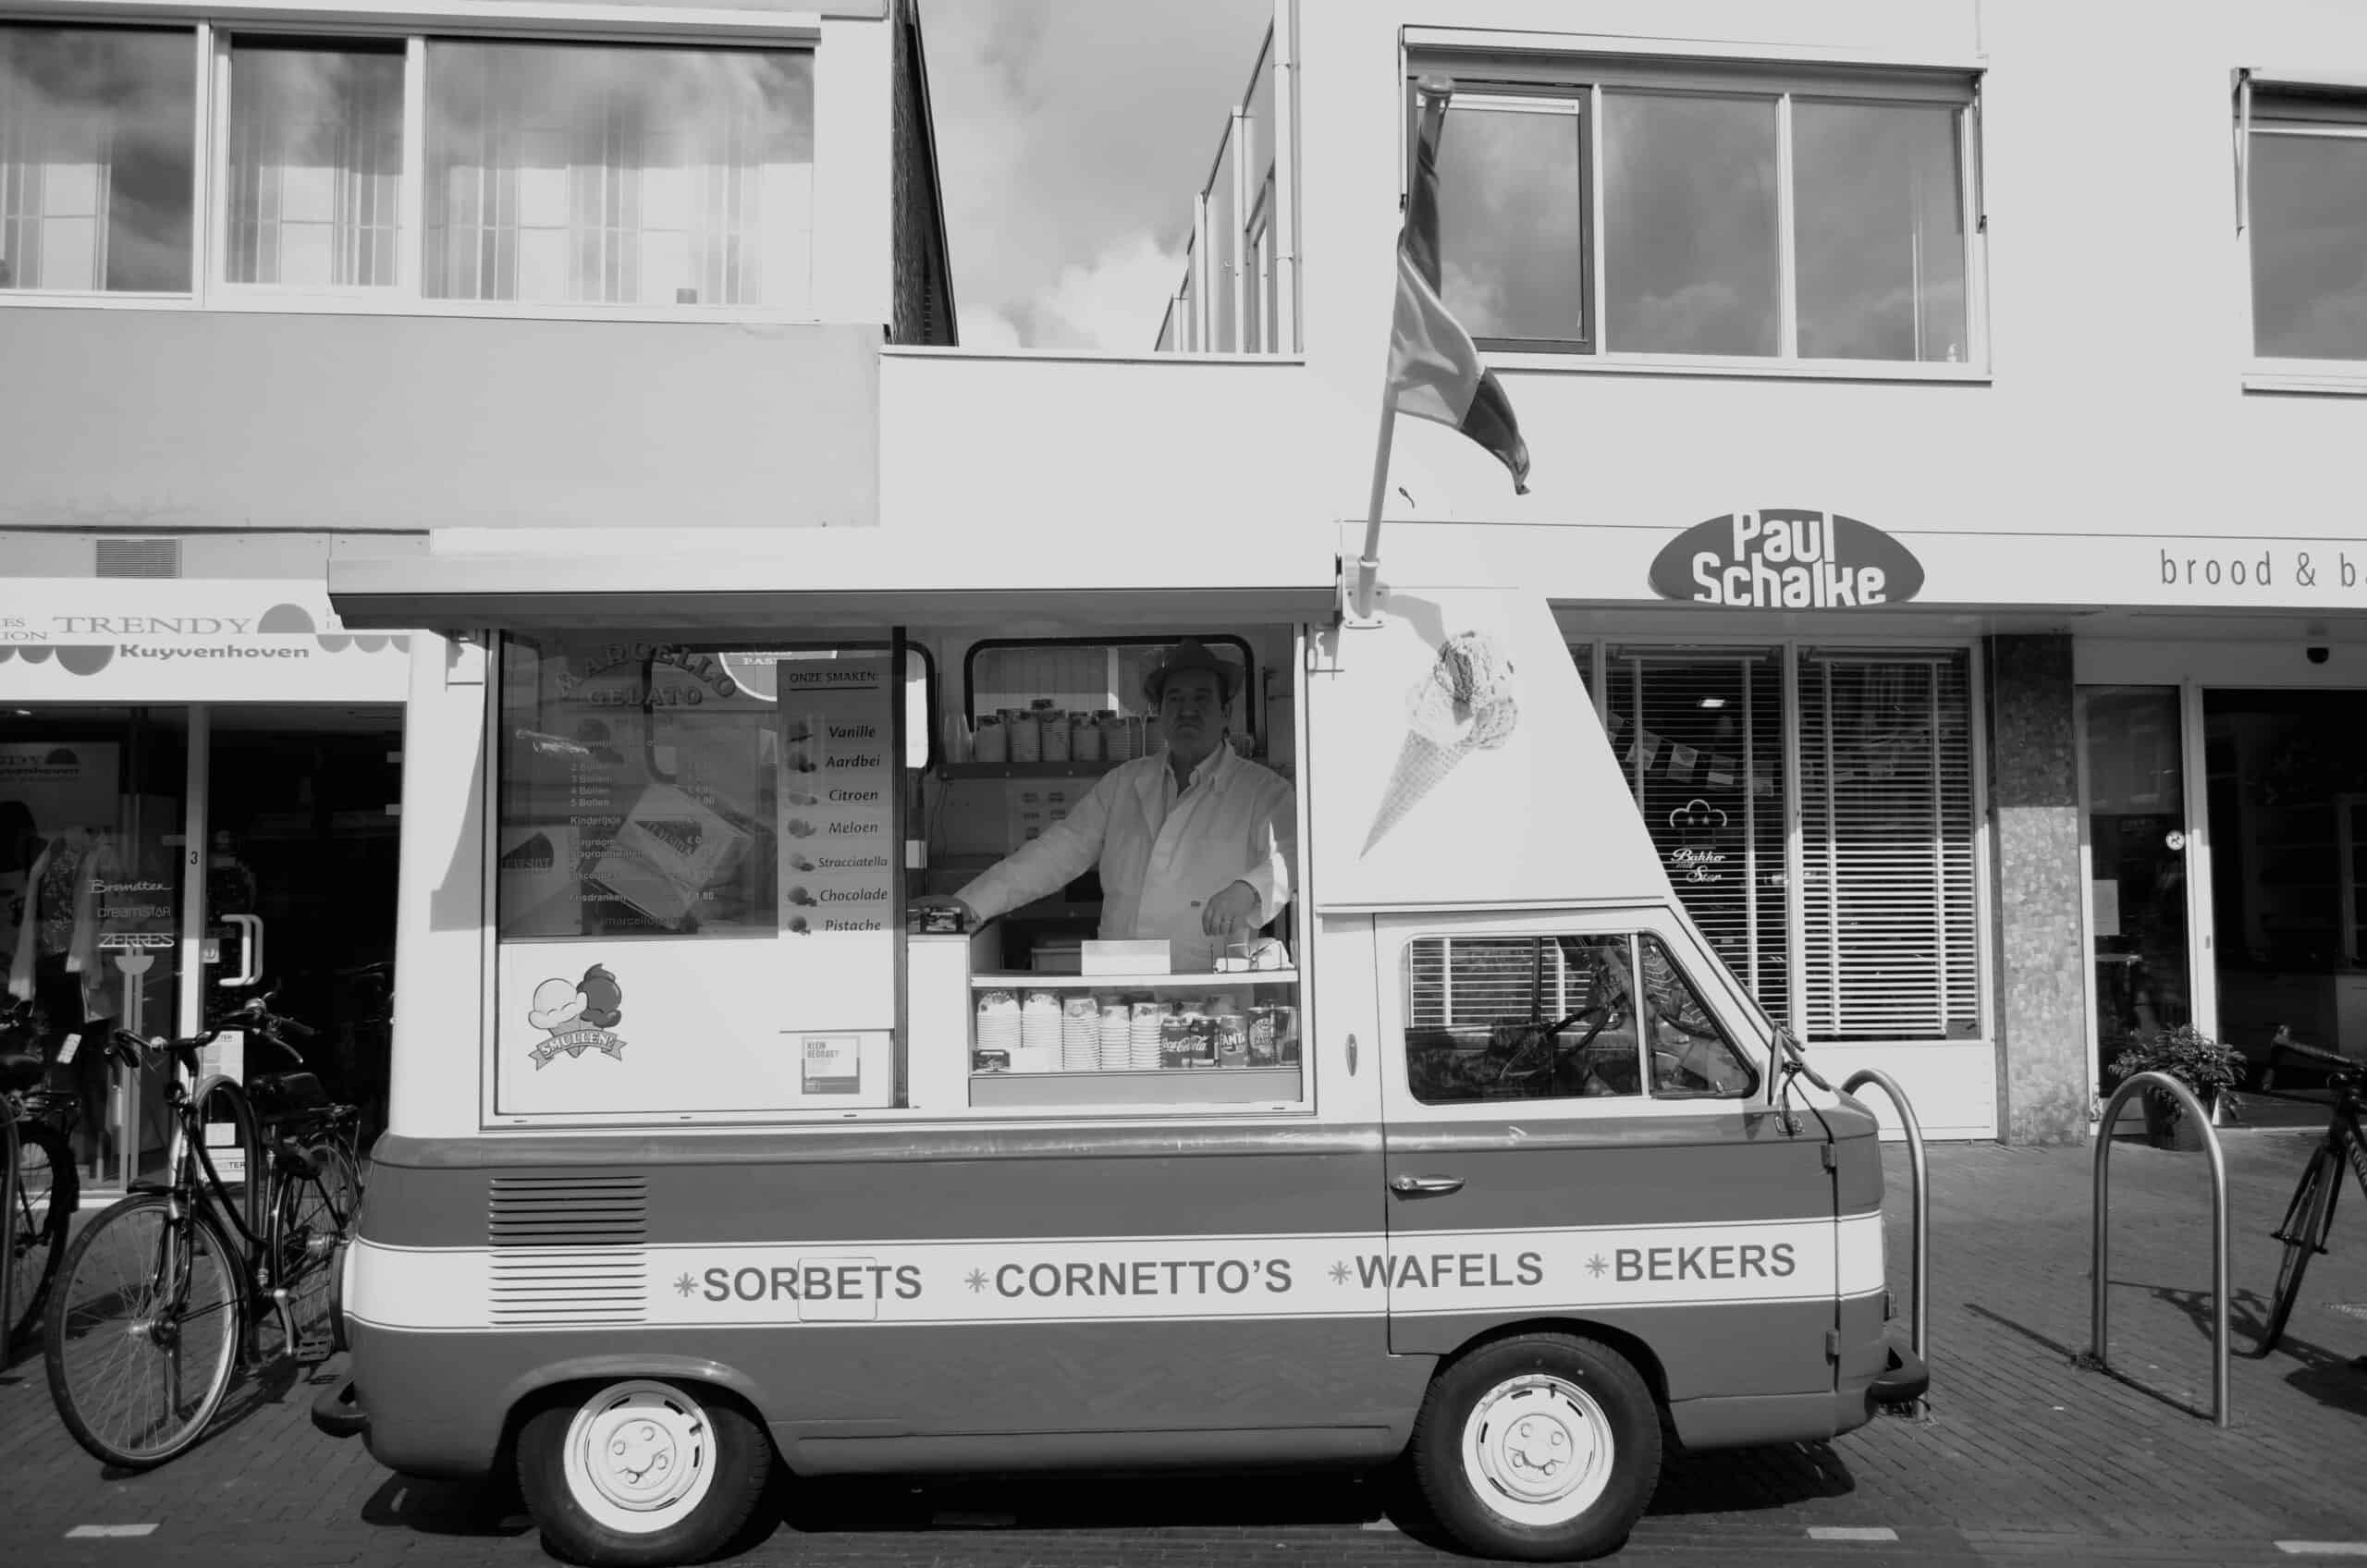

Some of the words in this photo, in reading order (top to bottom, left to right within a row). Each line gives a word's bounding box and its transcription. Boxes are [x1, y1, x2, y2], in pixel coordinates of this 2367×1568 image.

[1732, 510, 1835, 562] Paul
[2161, 548, 2272, 585] brood
[2296, 552, 2315, 586] &
[2339, 552, 2367, 587] b
[1691, 551, 1886, 607] Schalke
[0, 618, 25, 627] ES
[52, 616, 252, 635] TRENDY
[0, 631, 47, 641] ION
[120, 643, 310, 660] Kuyvenhoven
[790, 673, 822, 682] ONZE
[828, 725, 877, 738] Vanille
[825, 754, 880, 768] Aardbei
[828, 789, 878, 802] Citroen
[828, 821, 878, 835] Meloen
[190, 851, 198, 865] 3
[818, 856, 889, 868] Stracciatella
[819, 888, 888, 902] Chocolade
[825, 919, 881, 933] Pistache
[98, 933, 175, 948] ZERRES
[1616, 1243, 1796, 1281] BEKERS
[1355, 1252, 1543, 1288] WAFELS
[704, 1265, 923, 1302] SORBETS
[995, 1259, 1293, 1297] CORNETTO'S
